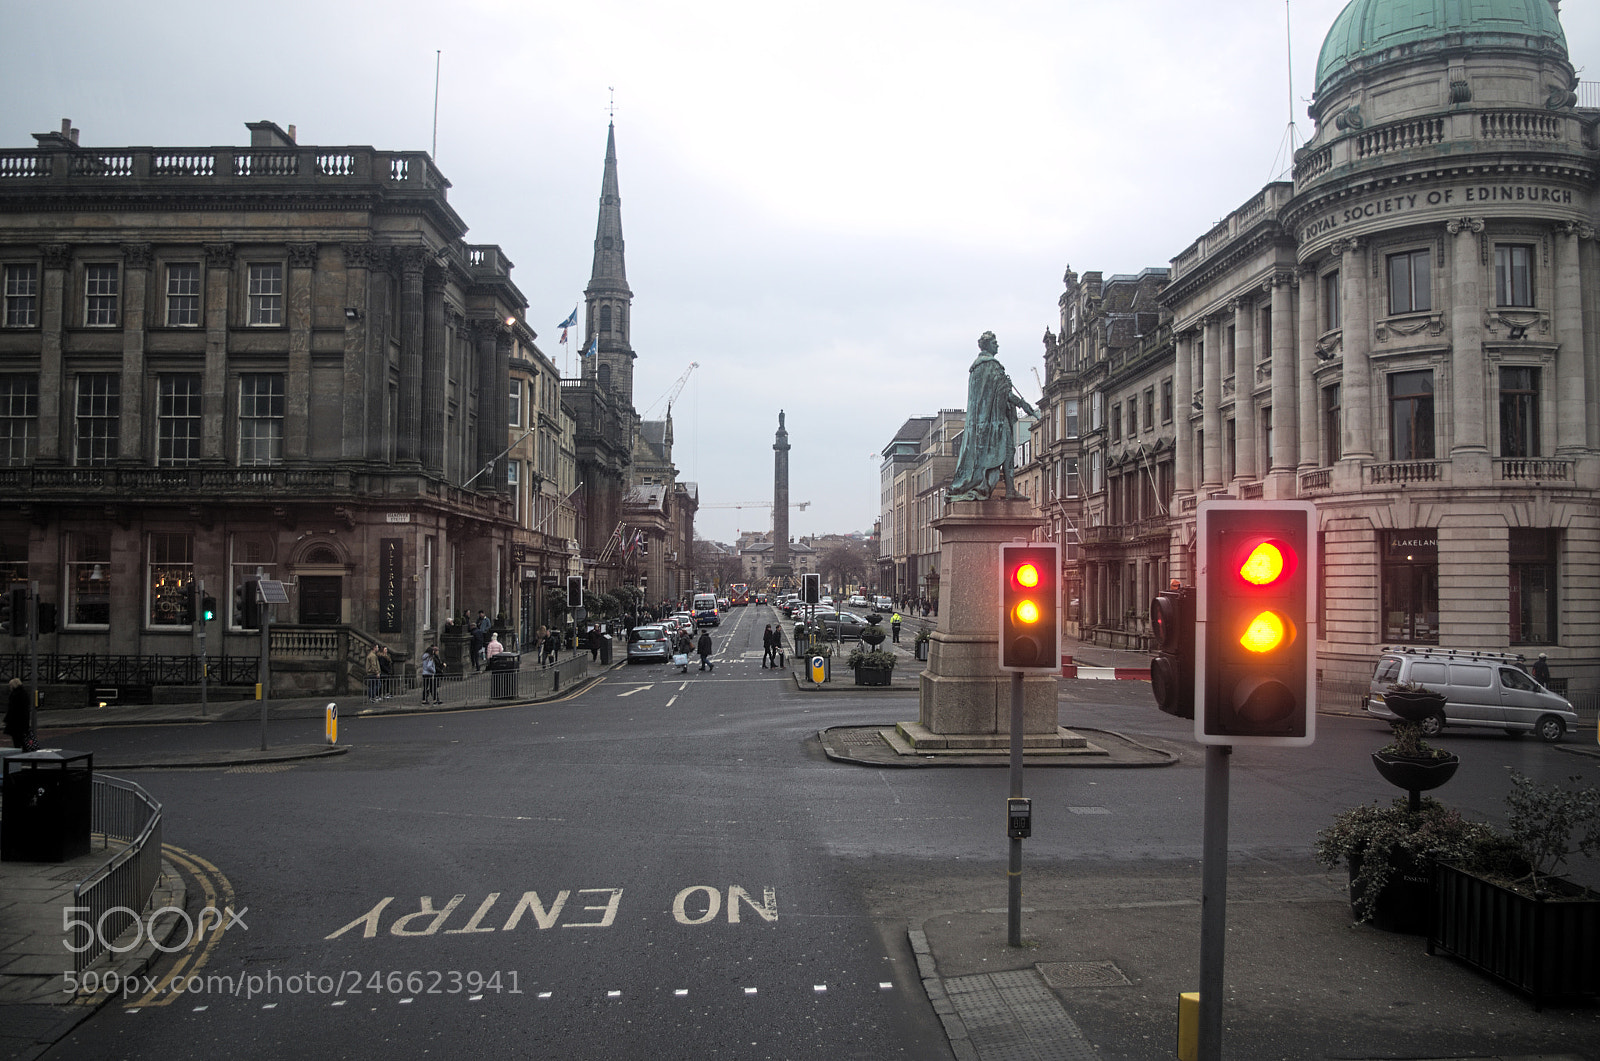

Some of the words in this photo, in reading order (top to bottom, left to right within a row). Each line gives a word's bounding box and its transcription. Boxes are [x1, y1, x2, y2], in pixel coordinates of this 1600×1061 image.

[1305, 215, 1337, 241] ROYAL
[1344, 194, 1417, 223] SOCIETY
[1427, 188, 1454, 206] OF
[1466, 186, 1572, 204] EDINBURGH
[1397, 539, 1438, 547] LAKELAN
[323, 887, 624, 940] ENTRY
[672, 884, 779, 925] NO
